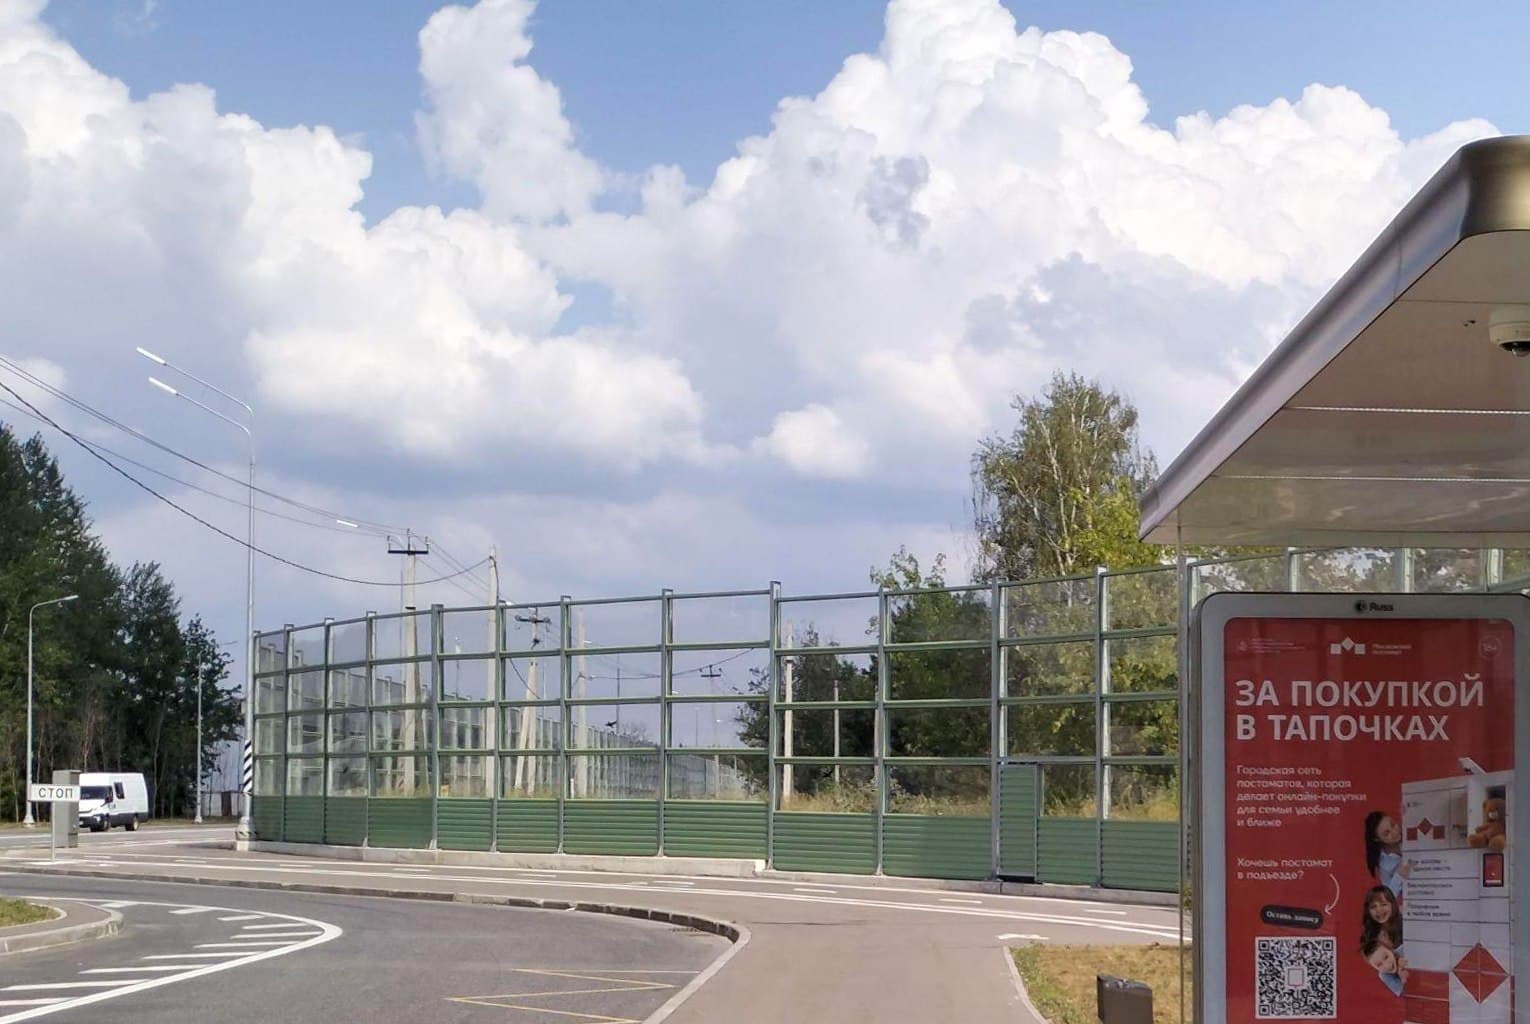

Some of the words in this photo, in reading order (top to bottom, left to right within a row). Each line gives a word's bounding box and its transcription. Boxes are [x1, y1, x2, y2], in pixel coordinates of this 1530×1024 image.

[1369, 602, 1394, 612] Russ
[1235, 680, 1279, 707] ЗА
[1291, 673, 1484, 707] ПОКУПКОЙ
[1236, 715, 1256, 740] В
[1268, 715, 1449, 741] ТАПОЧКАХ
[1236, 765, 1295, 776] Городская
[1297, 767, 1322, 775] сеть
[1236, 780, 1304, 789] постаматов,
[1307, 780, 1352, 789] которая
[38, 787, 73, 799] СТОП
[1236, 793, 1274, 802] делает
[1277, 792, 1367, 803] онлайн-покупки
[1236, 806, 1257, 815] для
[1258, 806, 1292, 815] семьи
[1295, 805, 1341, 816] удобнее
[1247, 818, 1282, 827] ближе
[1237, 857, 1279, 867] Хочешь
[1281, 859, 1333, 868] постамат
[1237, 871, 1244, 879] в
[1246, 870, 1304, 880] подъезде?
